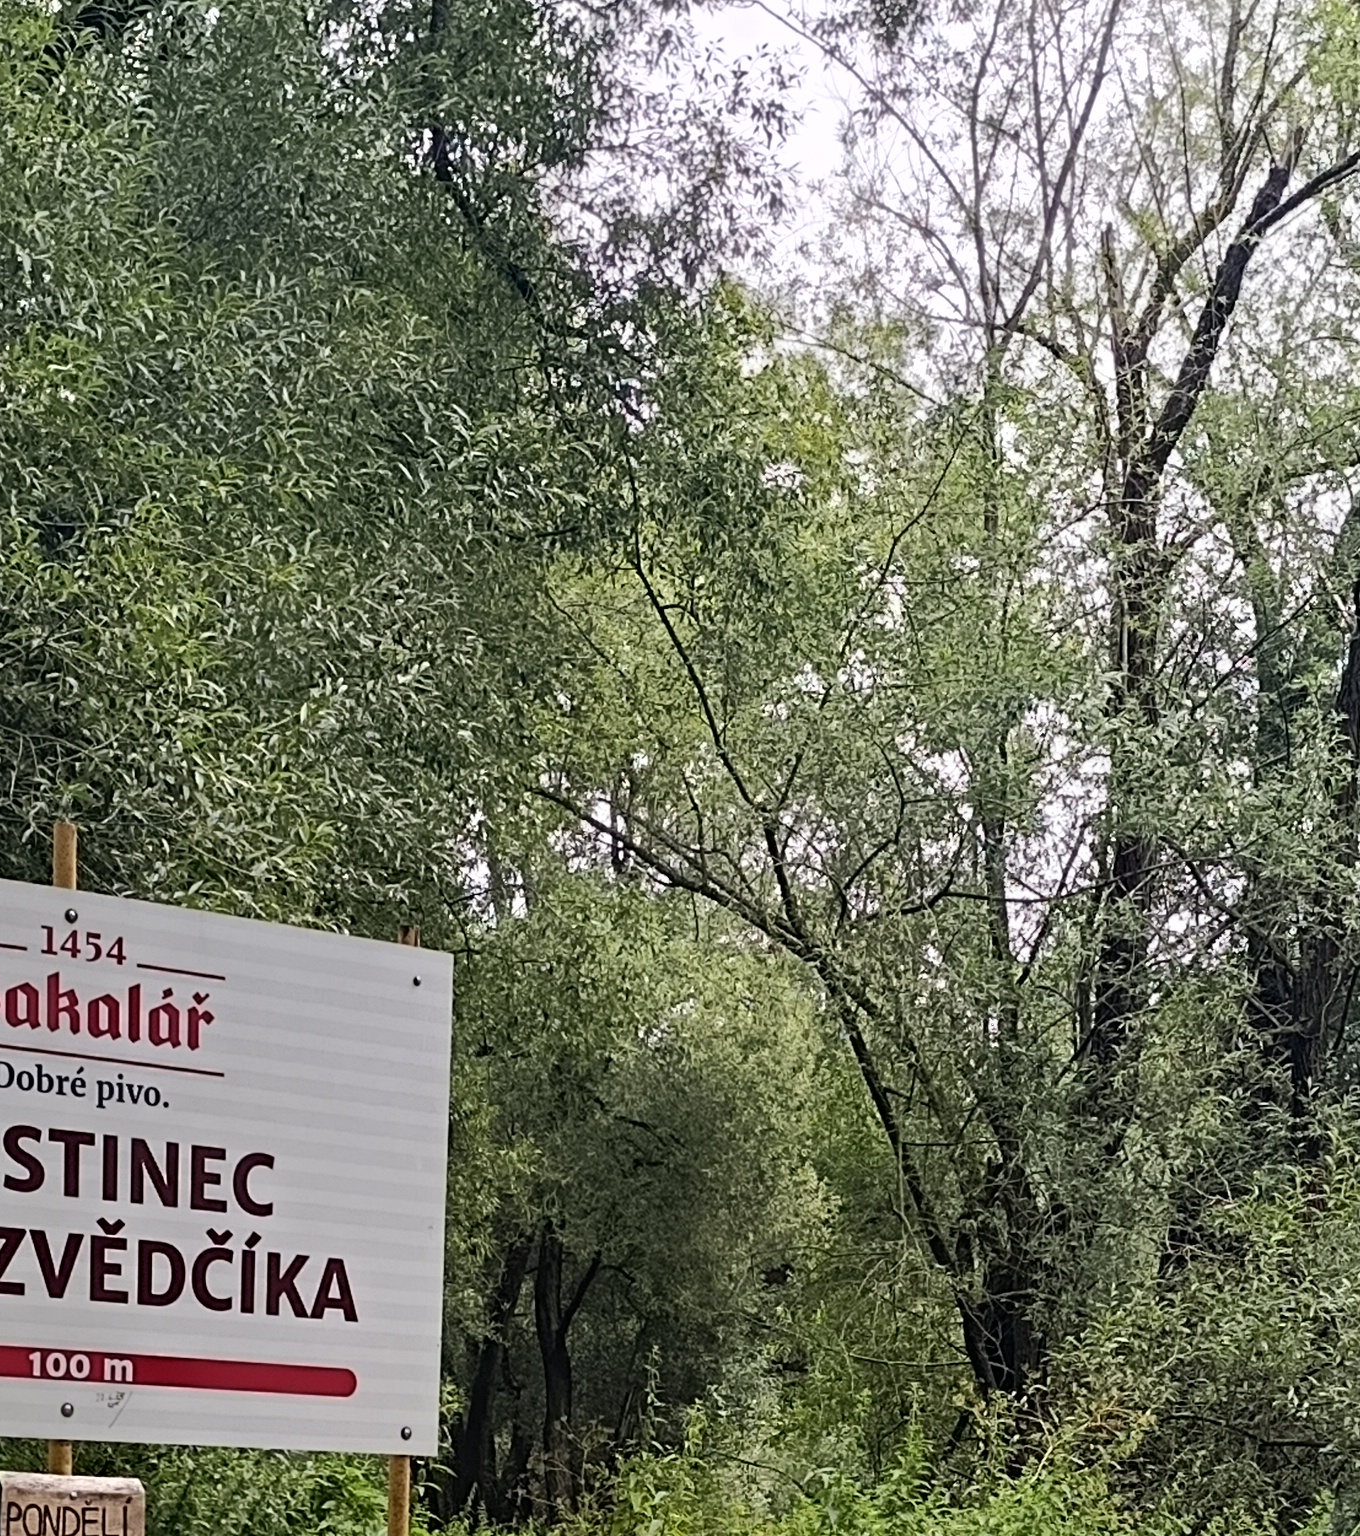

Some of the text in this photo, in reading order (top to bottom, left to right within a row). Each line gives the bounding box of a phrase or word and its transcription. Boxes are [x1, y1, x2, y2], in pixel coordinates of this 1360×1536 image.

[41, 925, 127, 965] 1454
[96, 1073, 170, 1109] pivo.
[28, 1351, 134, 1382] 100 m
